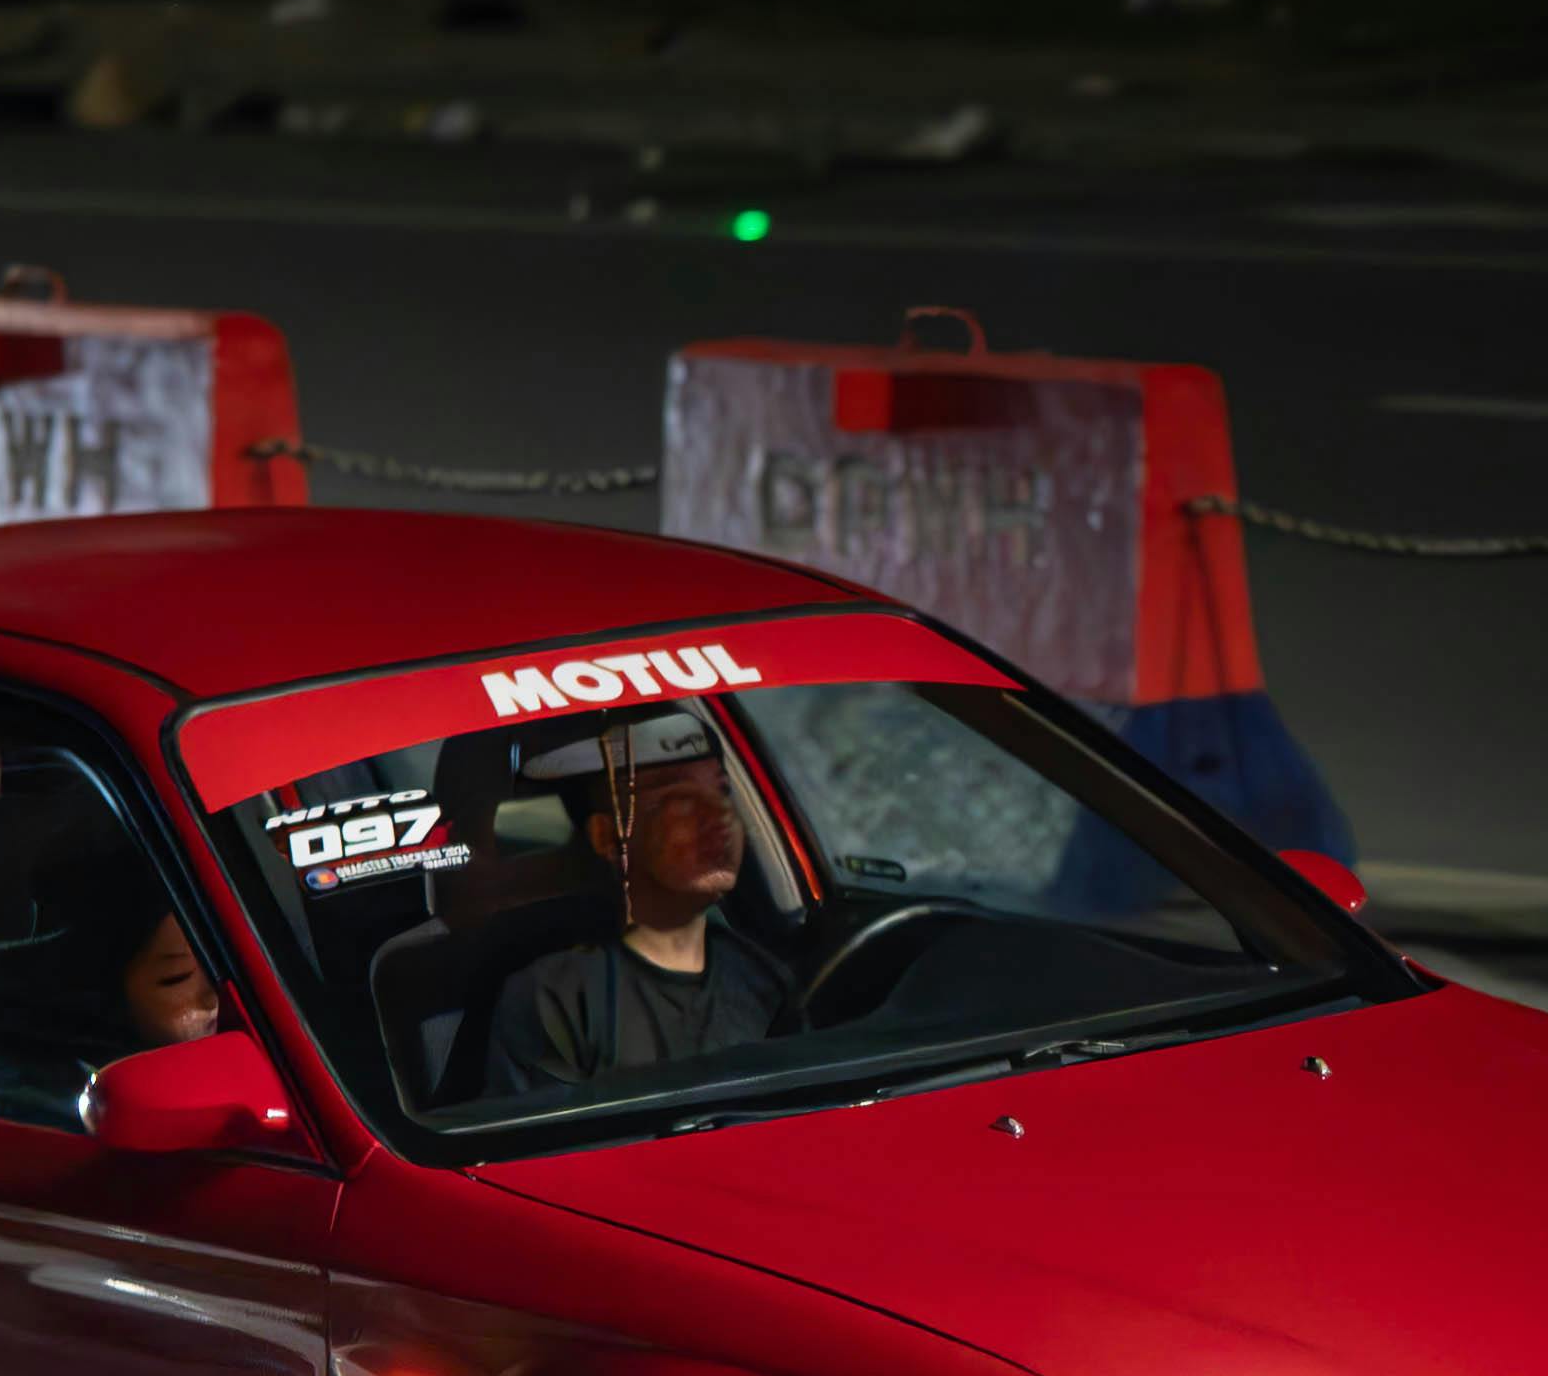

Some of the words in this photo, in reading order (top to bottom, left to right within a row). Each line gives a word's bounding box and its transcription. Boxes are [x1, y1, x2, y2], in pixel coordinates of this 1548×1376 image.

[481, 644, 761, 717] MOTUL
[265, 789, 429, 831] NITTO
[289, 803, 441, 868] 097
